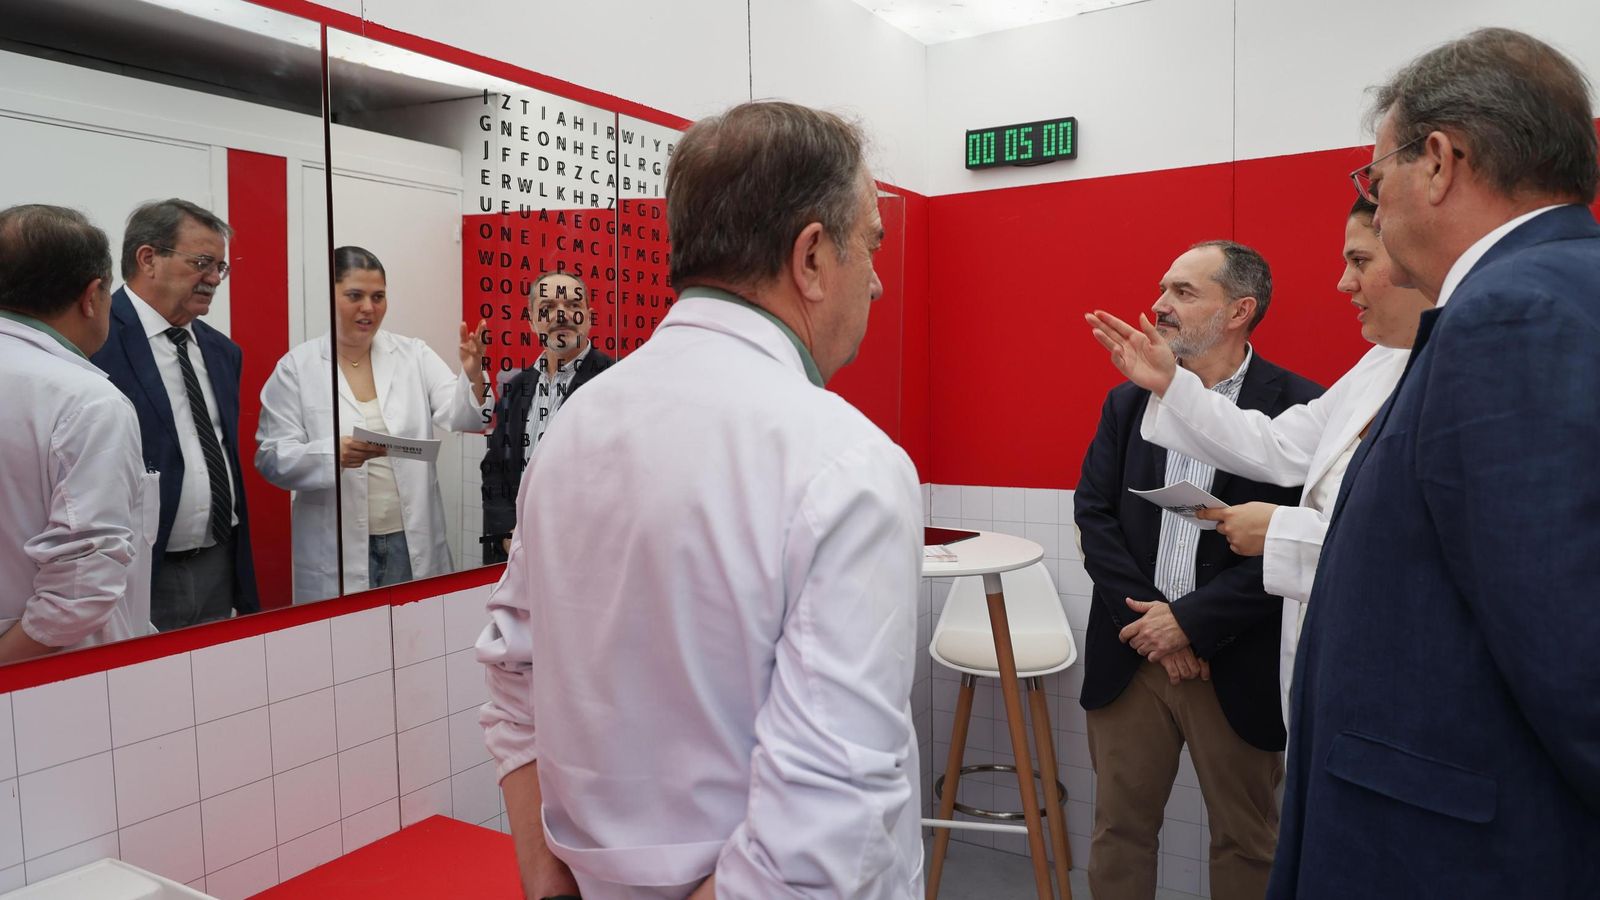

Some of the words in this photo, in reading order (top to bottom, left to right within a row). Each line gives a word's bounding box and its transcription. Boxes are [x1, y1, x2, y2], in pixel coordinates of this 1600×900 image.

[968, 133, 995, 165] 00
[1005, 127, 1032, 160] 05
[1043, 121, 1072, 156] 00
